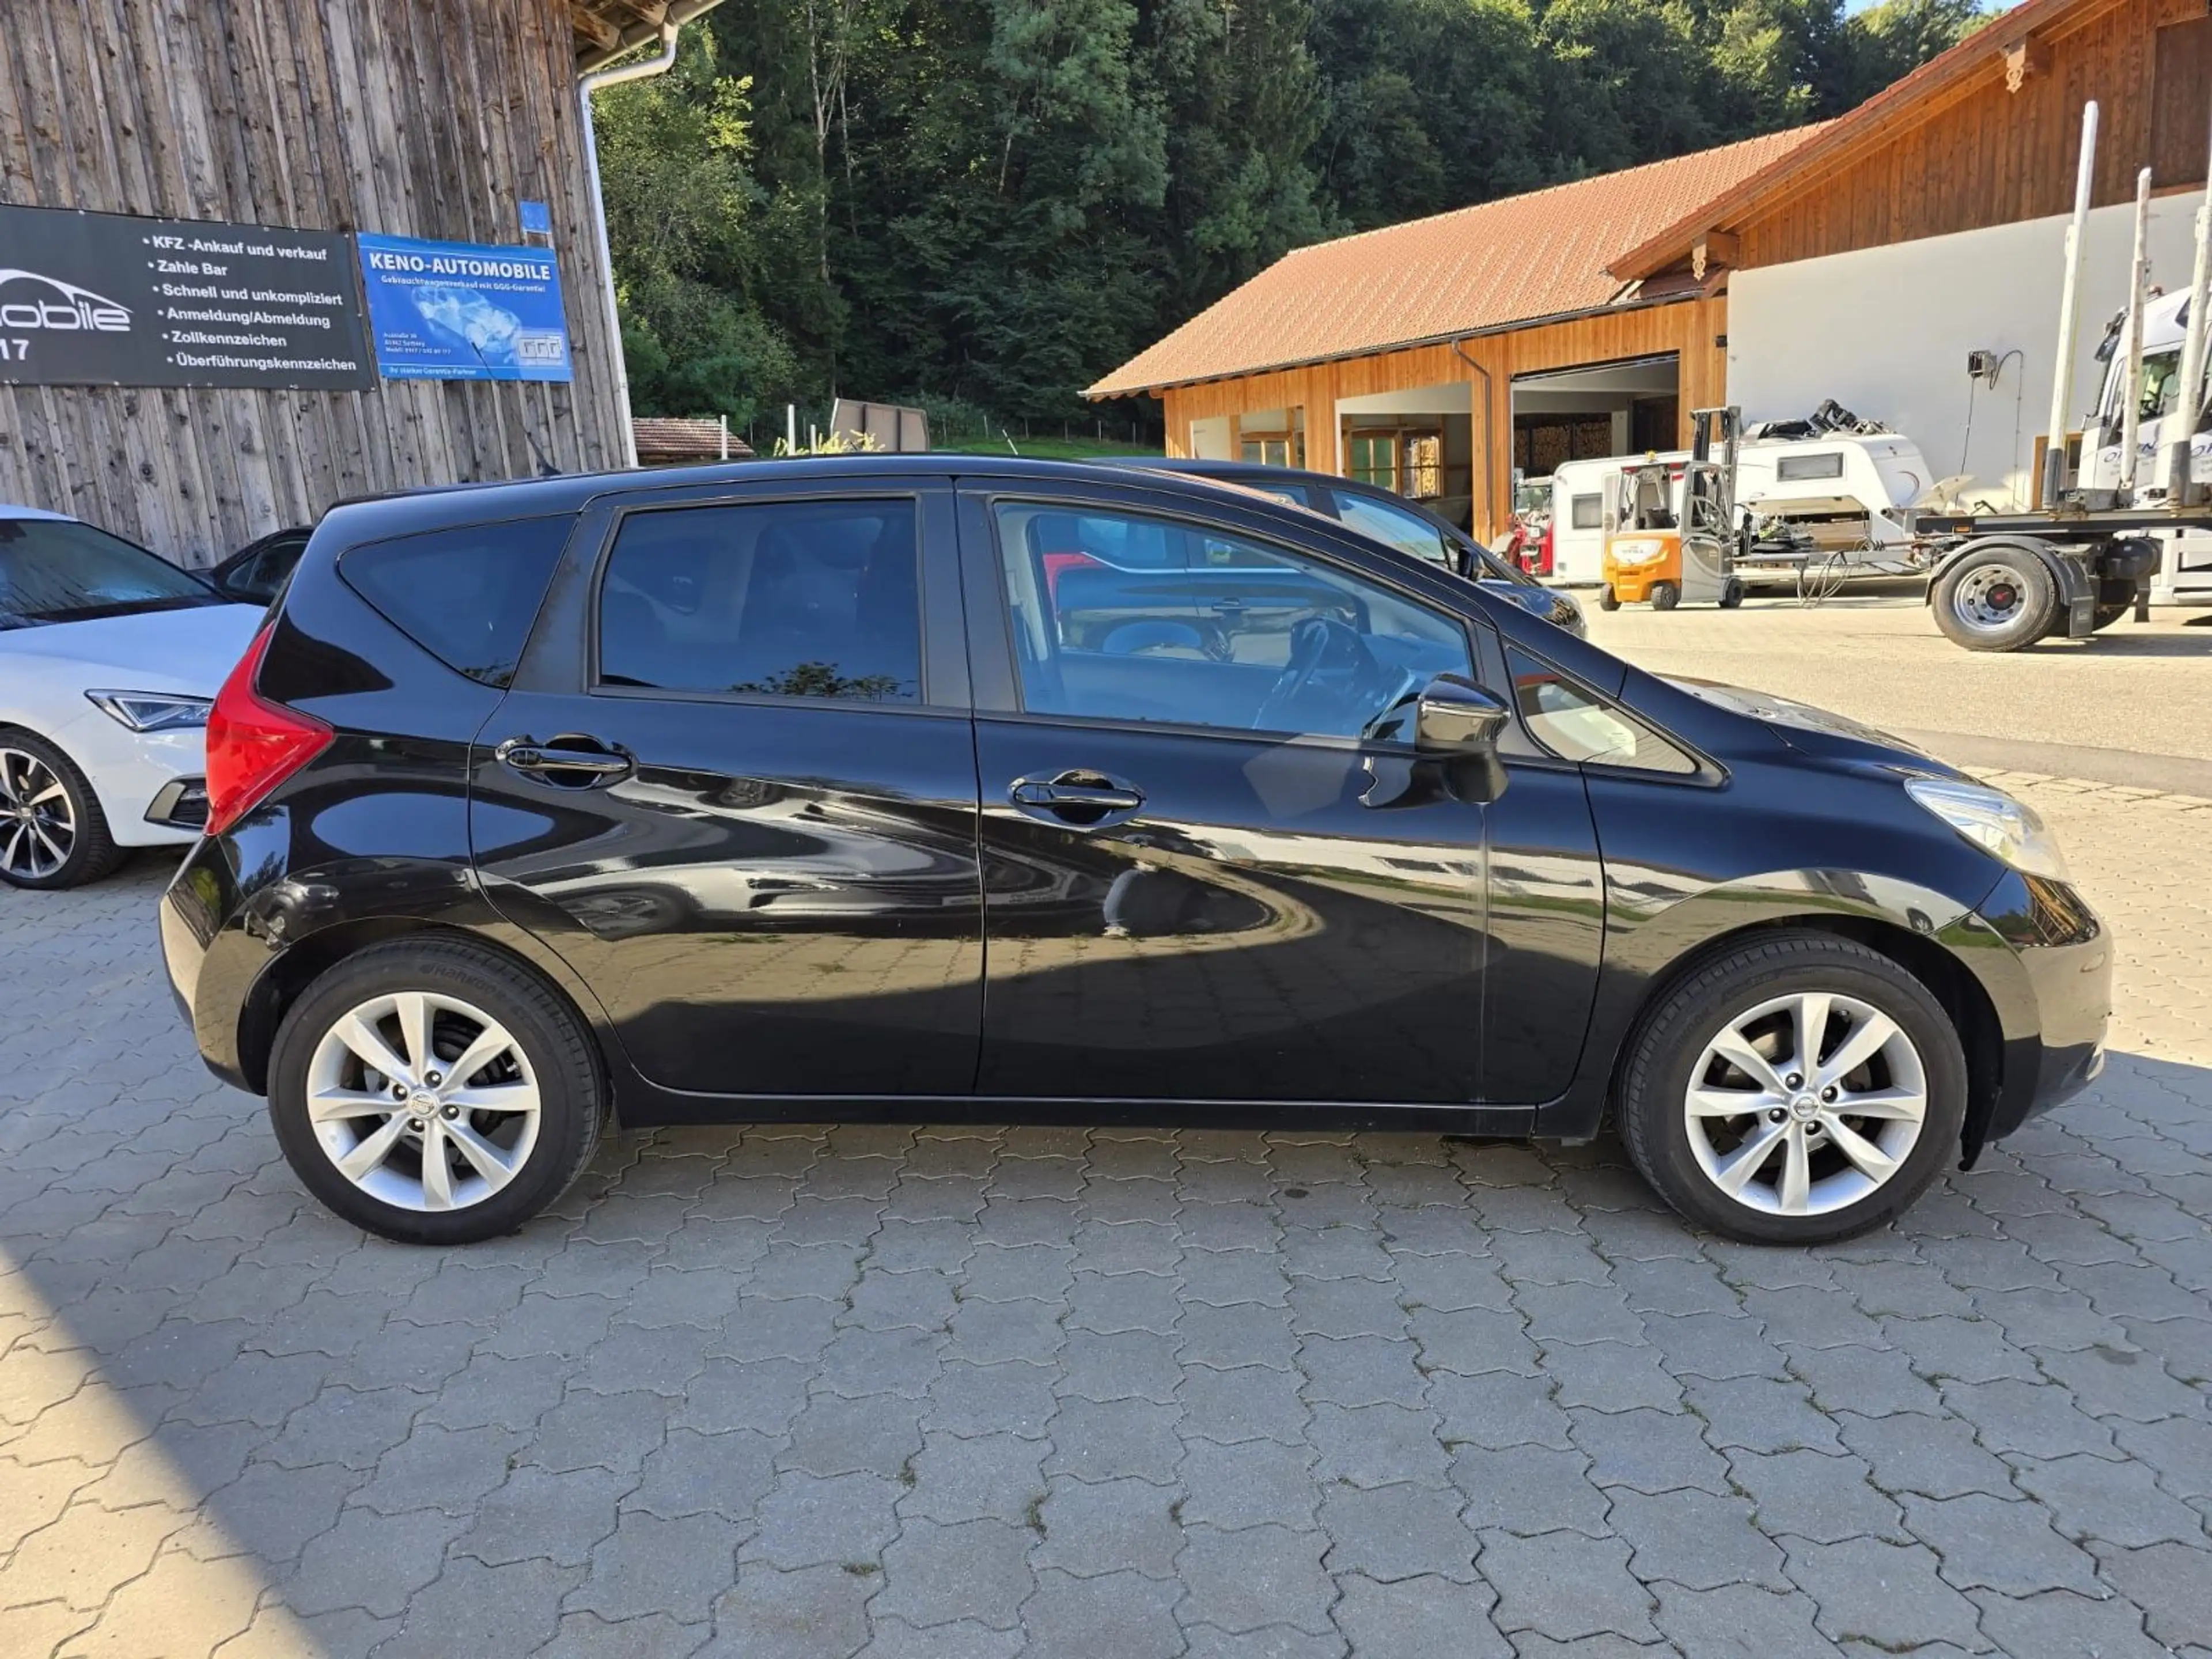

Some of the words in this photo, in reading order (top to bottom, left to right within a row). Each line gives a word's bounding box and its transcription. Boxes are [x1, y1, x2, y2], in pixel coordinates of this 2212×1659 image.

[152, 235, 185, 250] KFZ
[247, 244, 275, 257] und
[276, 246, 327, 260] verkauf
[157, 259, 199, 274] Zahle
[202, 262, 228, 276] Bar
[369, 252, 551, 280] KENO-AUTOMOBILE
[161, 283, 218, 298] Schnell
[221, 288, 248, 300] und
[251, 289, 344, 306] unkompliziert
[0, 298, 131, 331] obile
[167, 307, 331, 329] Anmeldung/Abmeldung
[171, 330, 287, 347] Zollkennzeichen
[176, 351, 357, 371] Überführungskennzeichen
